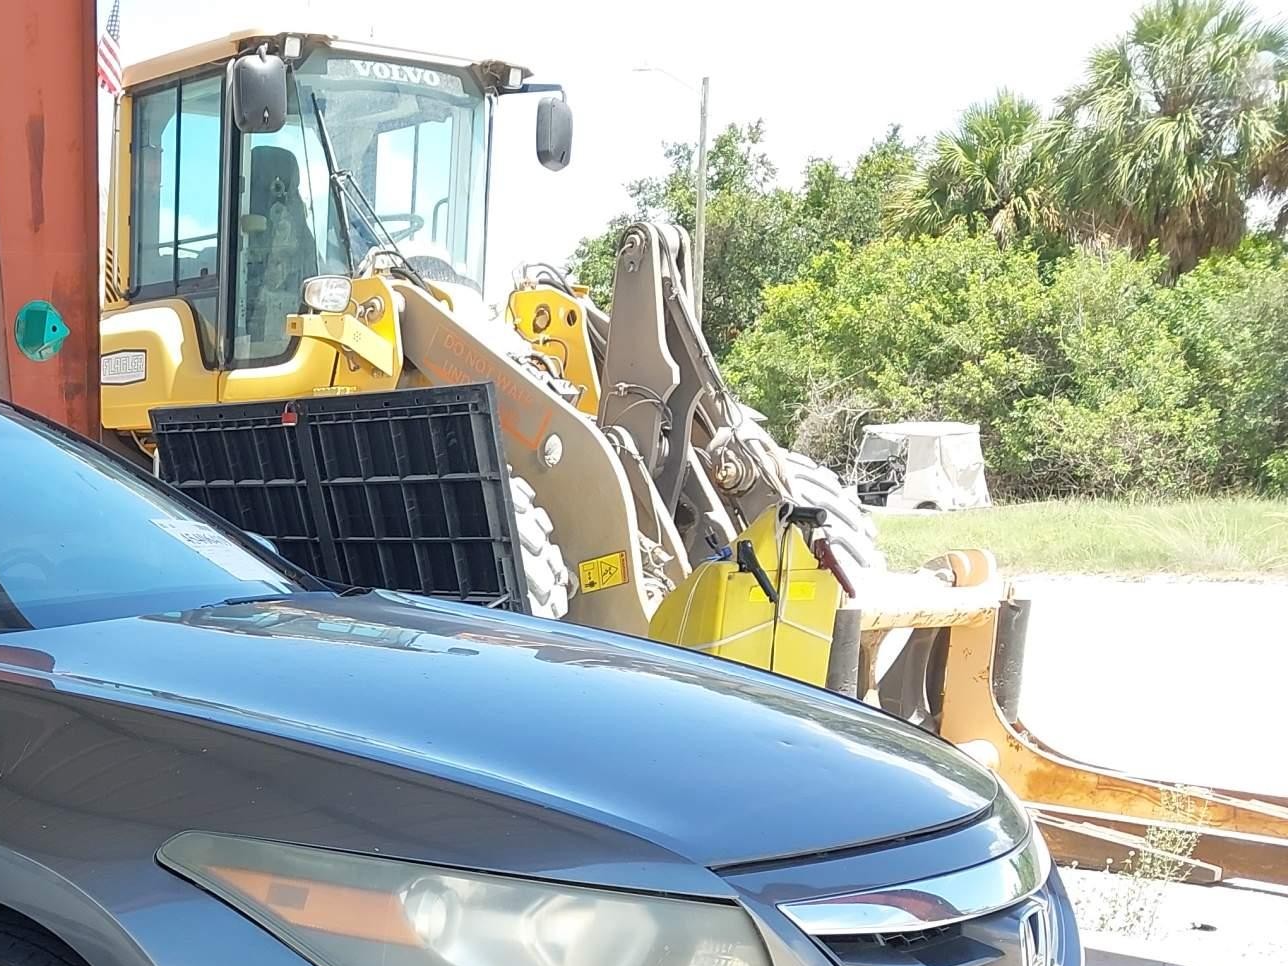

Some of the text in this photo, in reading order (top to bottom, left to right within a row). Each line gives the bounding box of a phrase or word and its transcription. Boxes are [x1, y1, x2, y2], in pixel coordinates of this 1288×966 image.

[350, 60, 440, 86] VOLVO
[443, 334, 464, 356] DO
[465, 355, 493, 378] NOT
